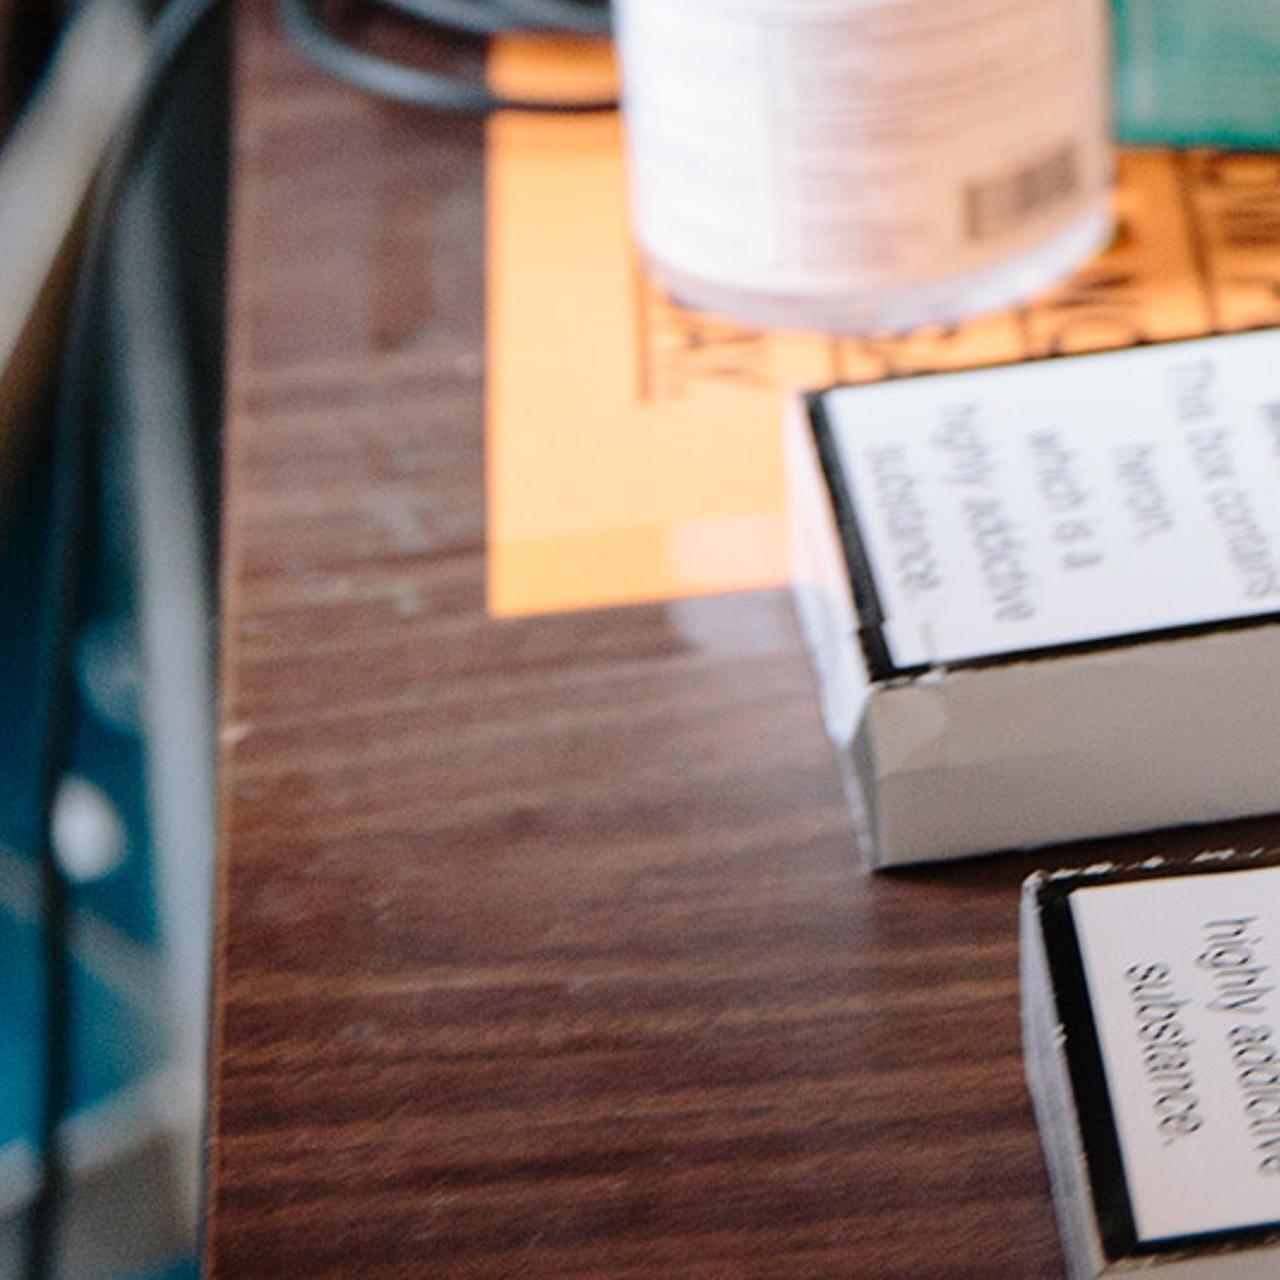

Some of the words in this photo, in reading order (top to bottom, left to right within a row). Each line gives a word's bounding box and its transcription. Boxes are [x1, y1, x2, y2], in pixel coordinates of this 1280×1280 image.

[1167, 357, 1216, 422] This
[1029, 426, 1088, 513] which
[1186, 425, 1235, 480] box
[961, 497, 1037, 622] addictive
[1195, 915, 1275, 1014] highly
[1125, 961, 1204, 1148] substance.
